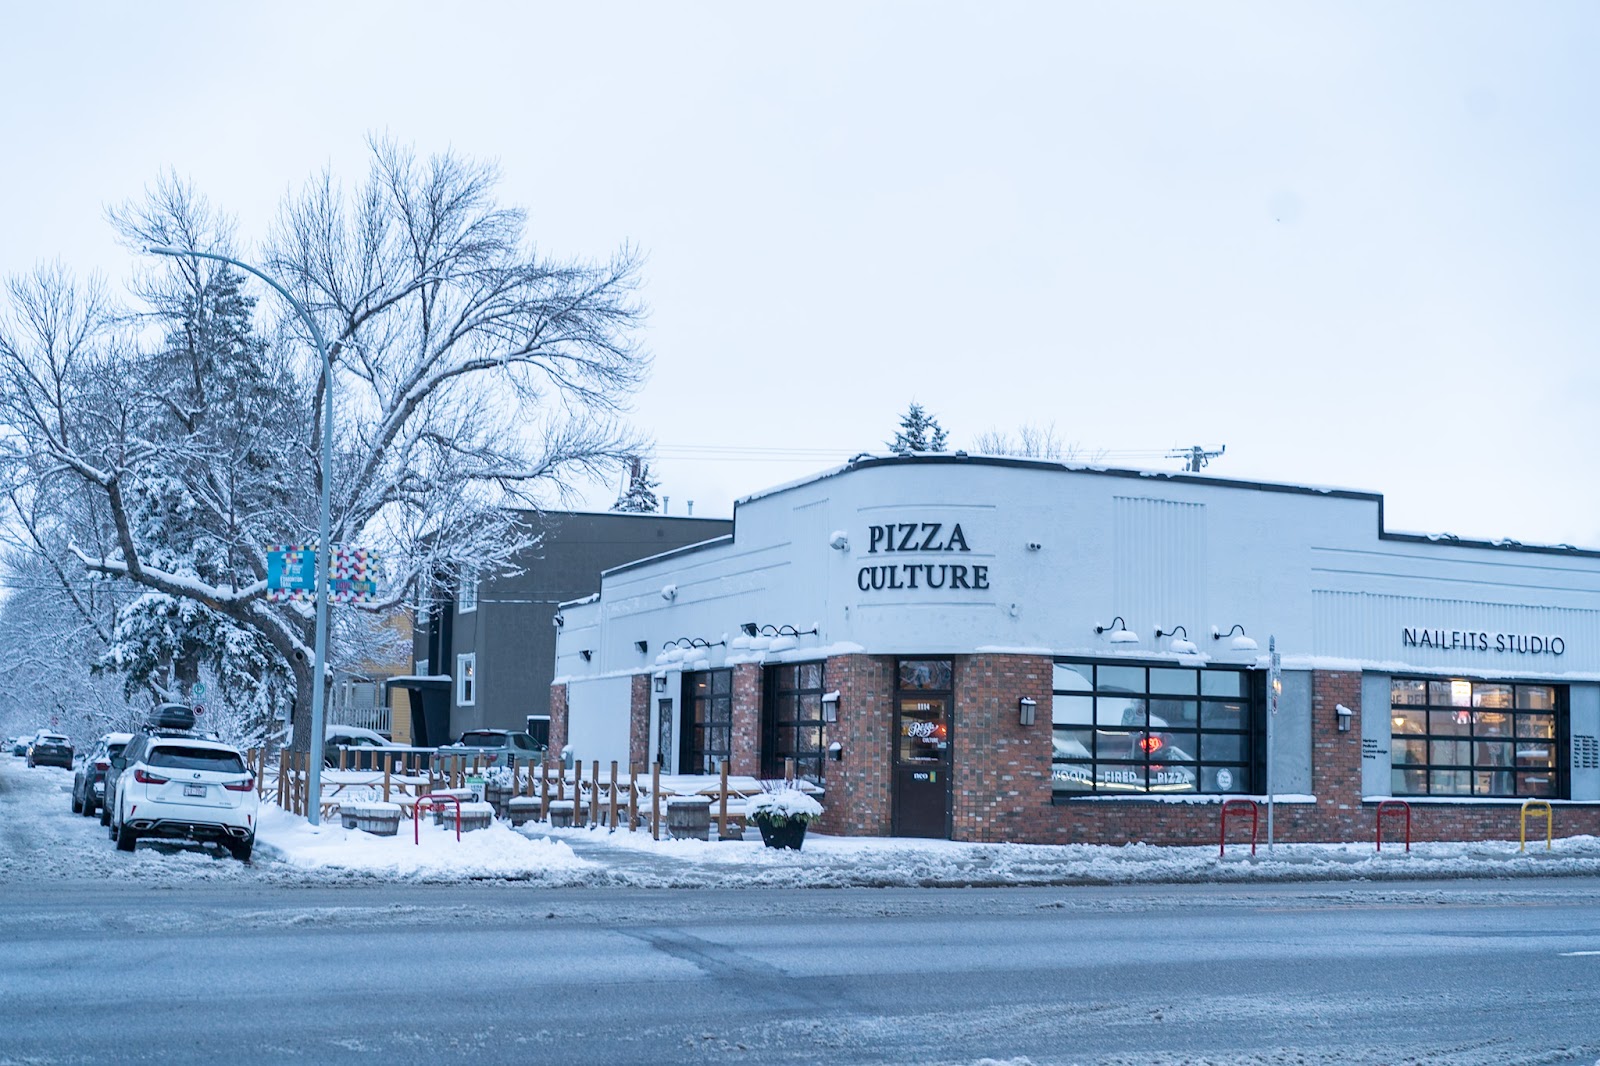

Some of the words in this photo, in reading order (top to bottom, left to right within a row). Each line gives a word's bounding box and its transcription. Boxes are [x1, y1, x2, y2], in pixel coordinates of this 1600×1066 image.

[868, 522, 971, 553] PIZZA
[857, 564, 990, 592] CULTURE
[1403, 627, 1488, 651] NAILFITS
[1496, 633, 1565, 655] STUDIO
[917, 703, 930, 711] 1114
[1051, 770, 1087, 782] WOOD
[1104, 771, 1138, 783] FIRED
[1157, 771, 1190, 784] PIZZA
